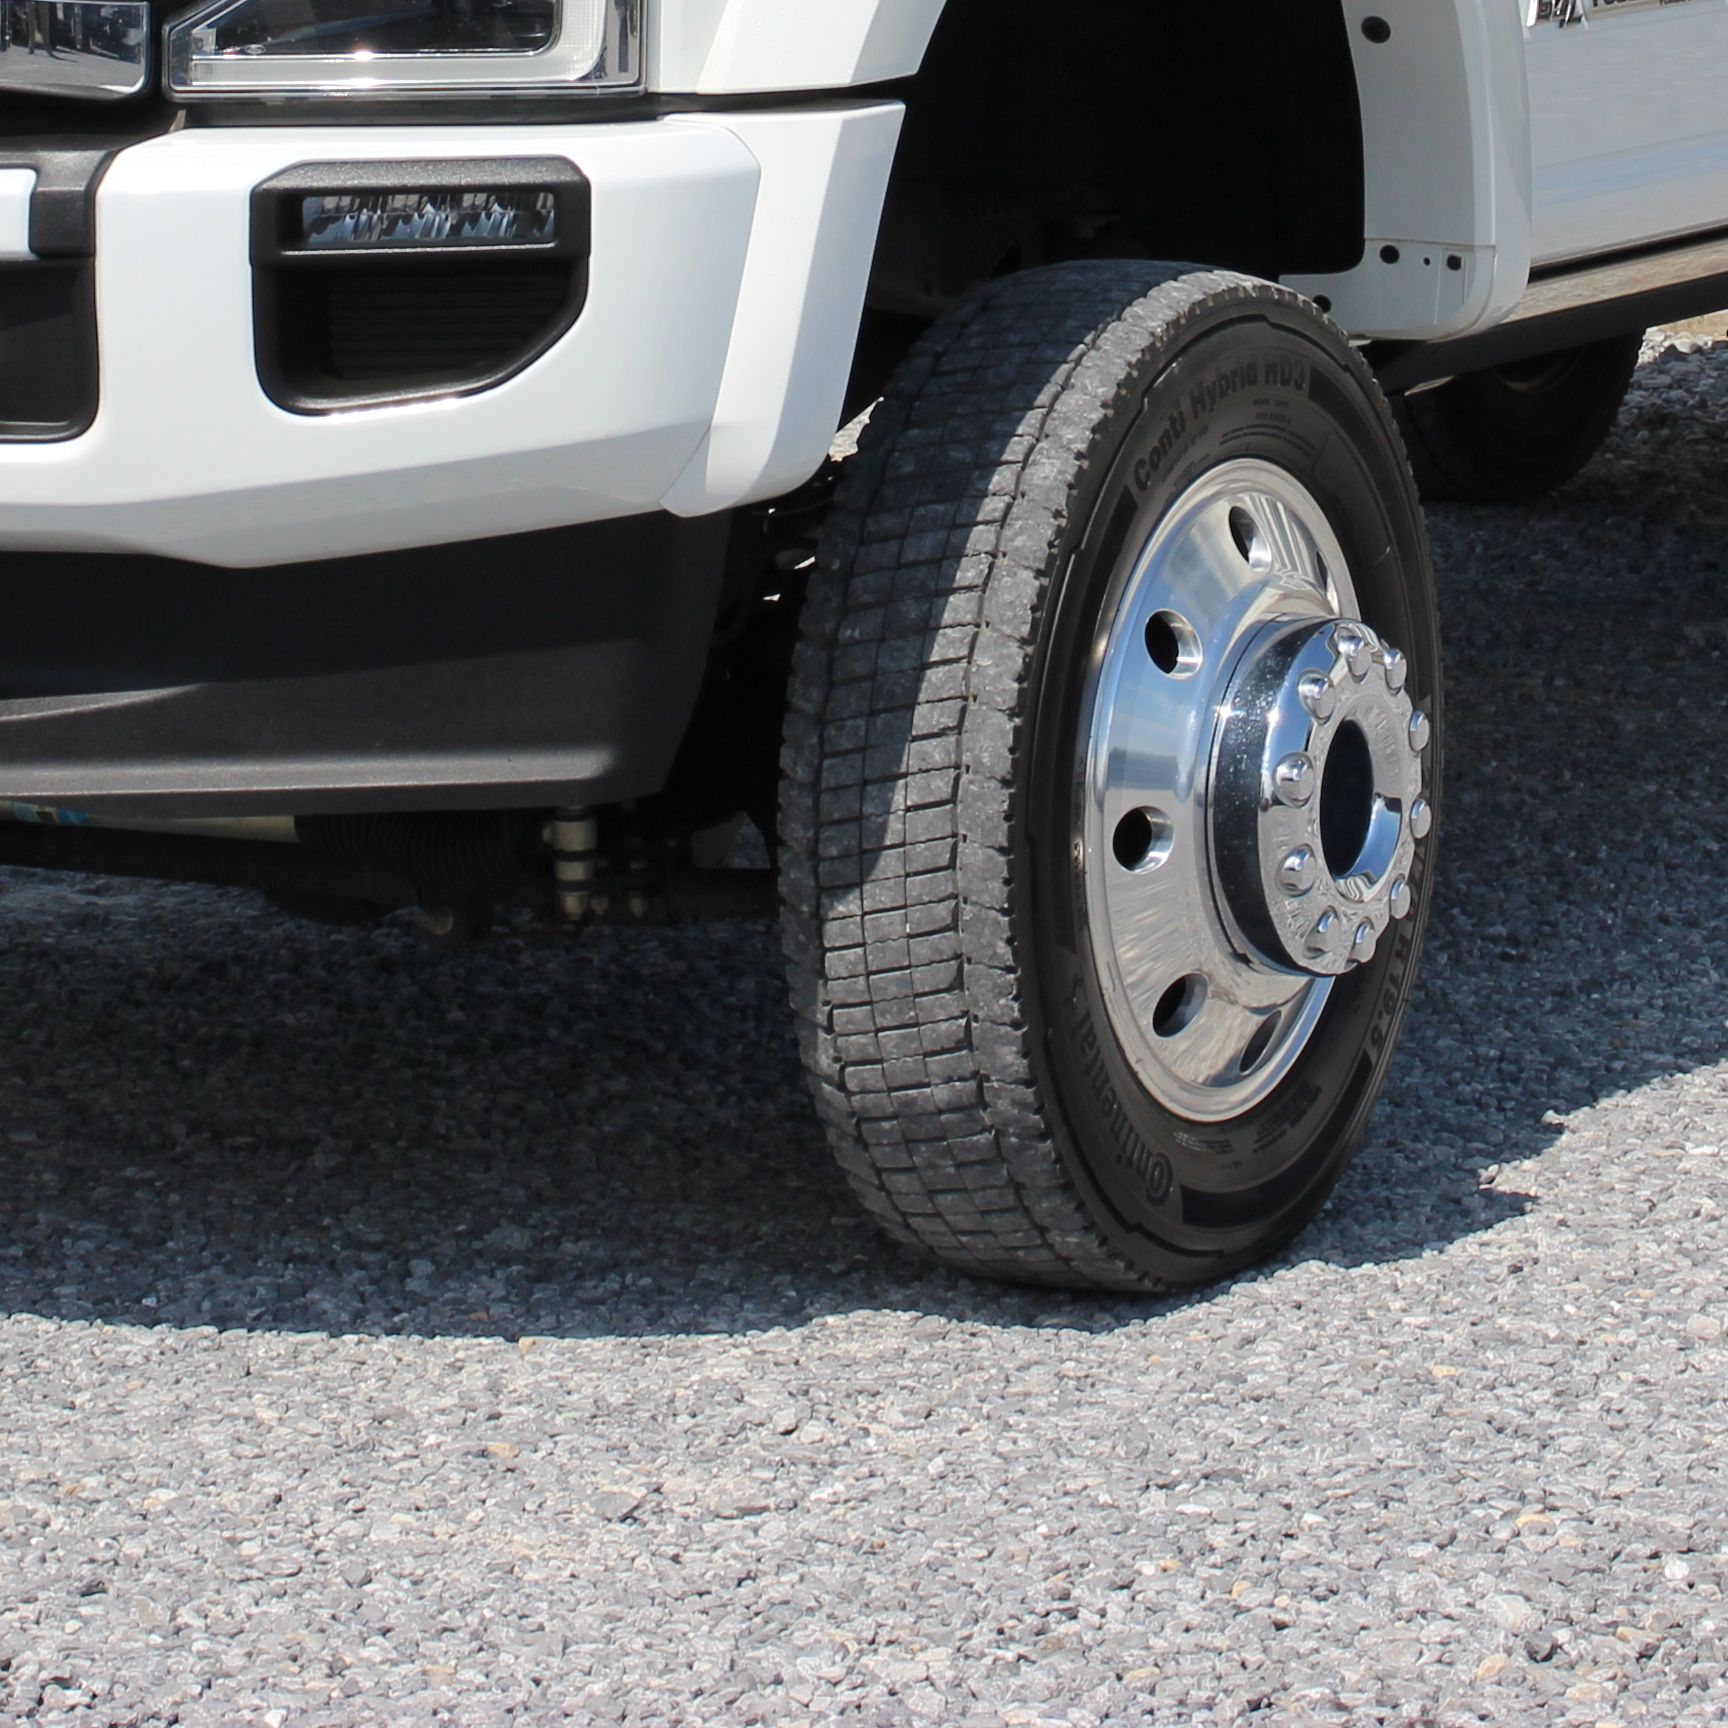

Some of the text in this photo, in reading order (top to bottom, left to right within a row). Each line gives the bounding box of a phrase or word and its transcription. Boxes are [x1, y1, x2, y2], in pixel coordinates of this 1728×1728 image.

[1134, 409, 1188, 492] Conti
[1188, 360, 1259, 420] Hybrid
[1069, 1005, 1174, 1207] Continental
